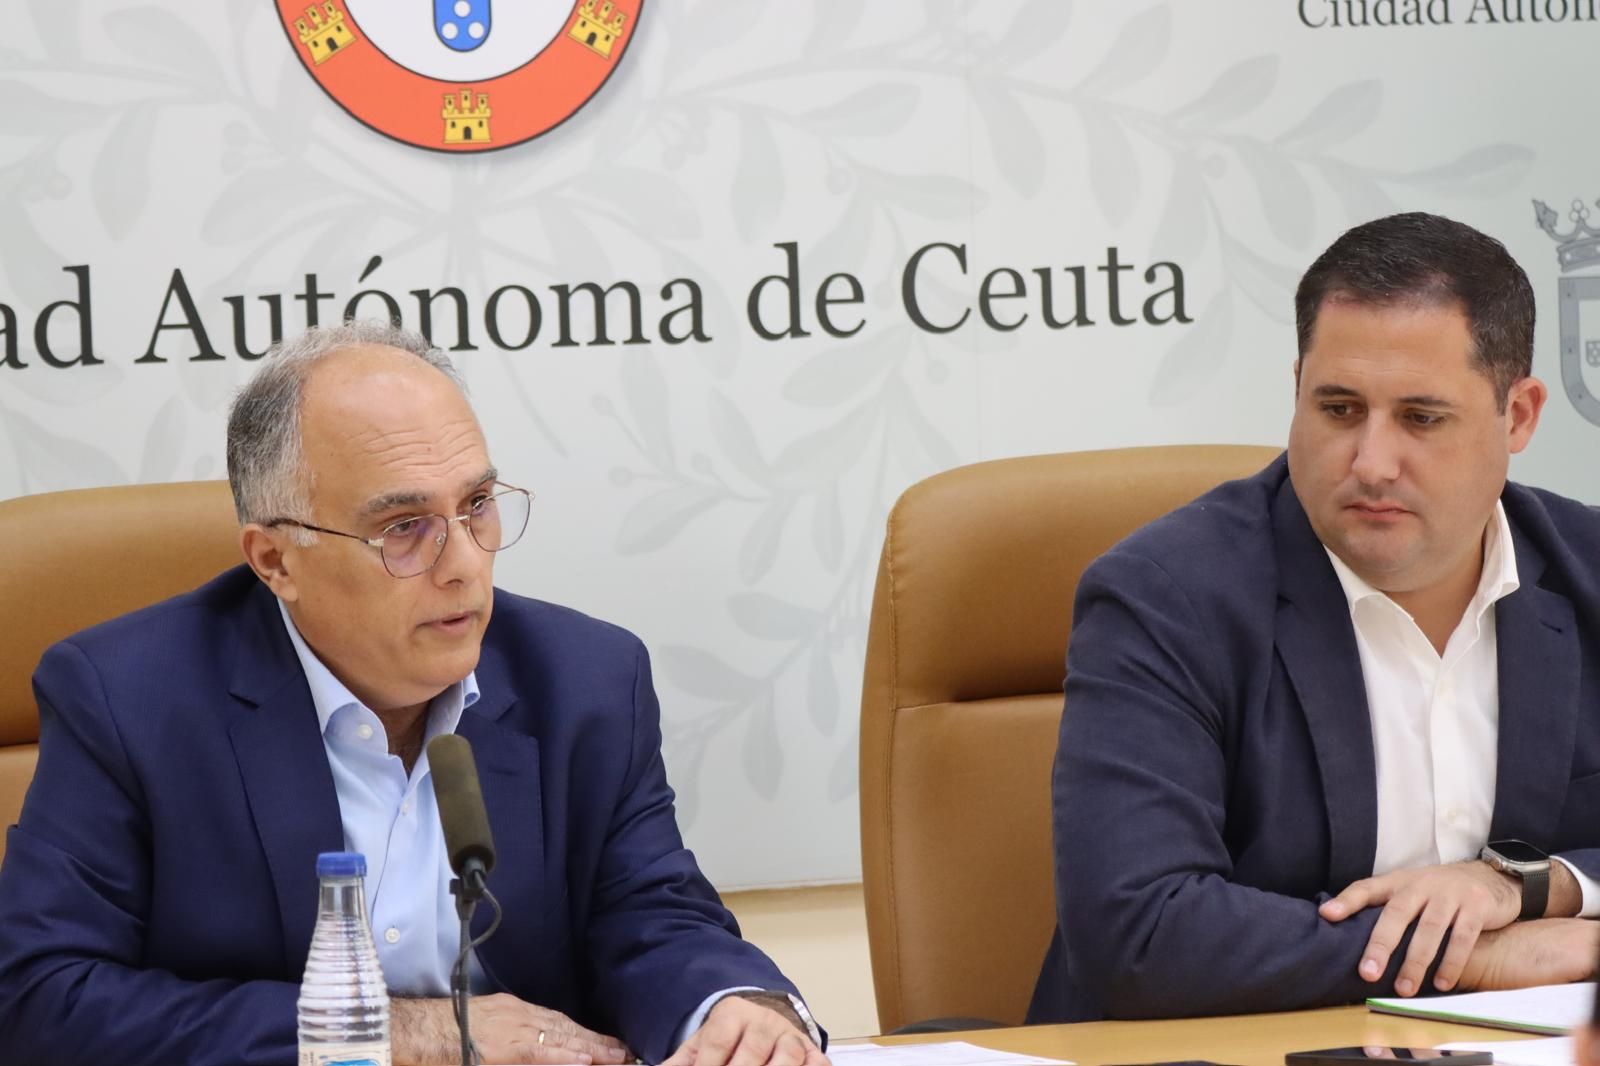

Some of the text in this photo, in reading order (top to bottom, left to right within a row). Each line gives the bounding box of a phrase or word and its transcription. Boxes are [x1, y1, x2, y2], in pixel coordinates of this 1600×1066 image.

[1297, 0, 1454, 28] Ciudad
[133, 255, 713, 364] Autónoma
[746, 241, 867, 341] de
[901, 242, 1194, 334] Ceuta
